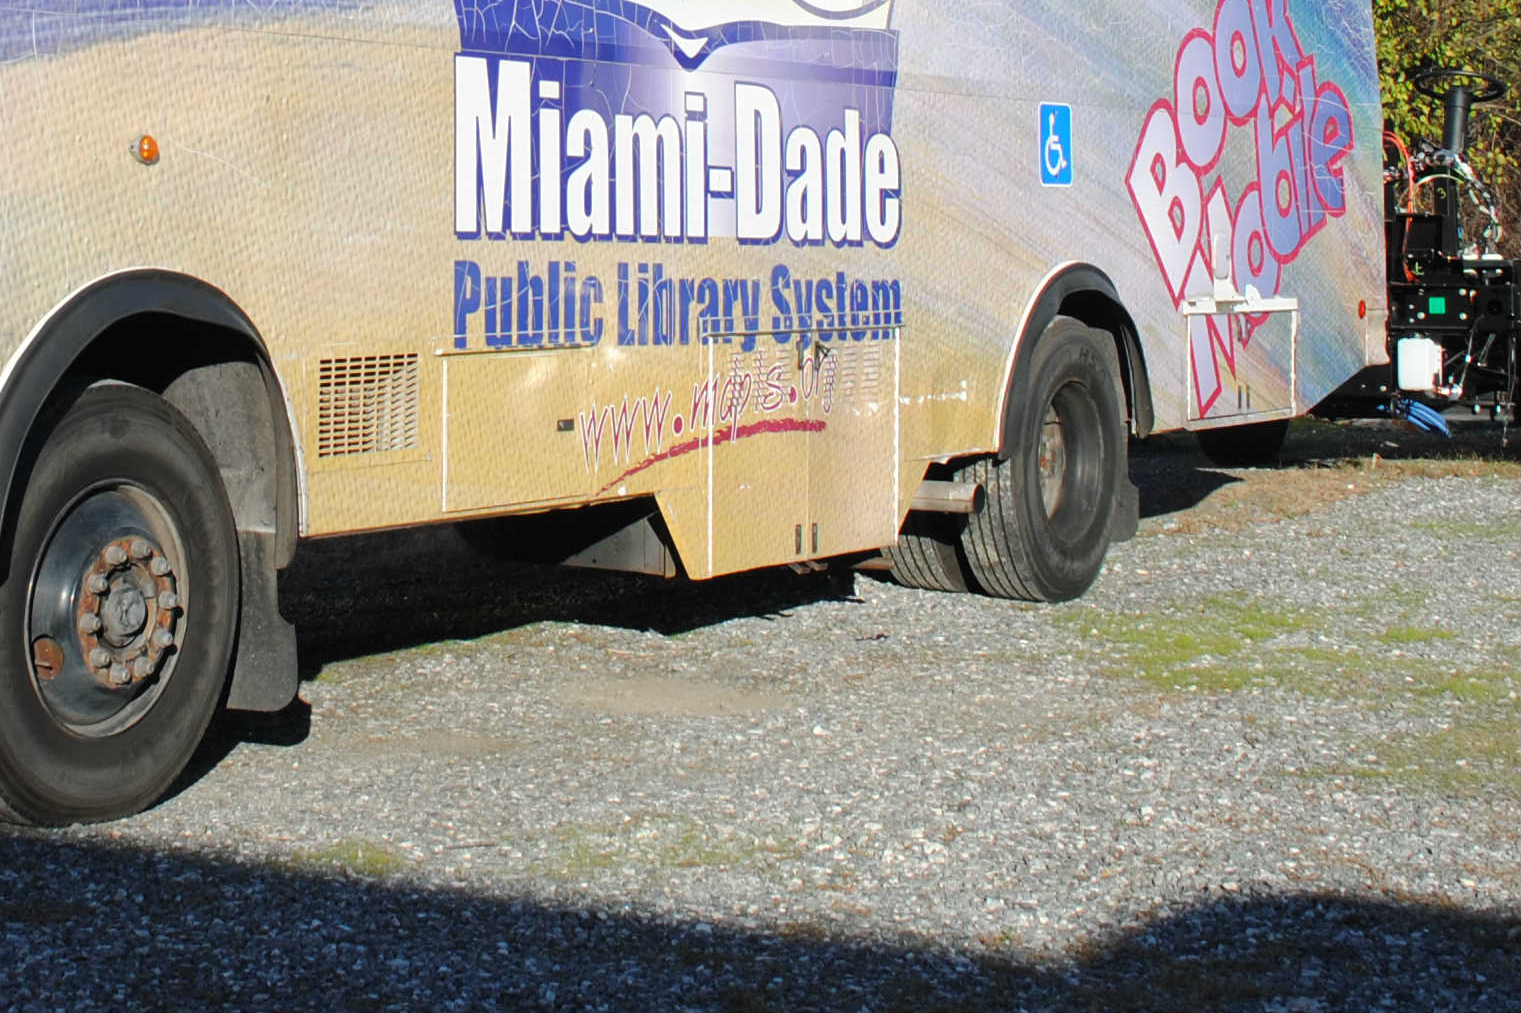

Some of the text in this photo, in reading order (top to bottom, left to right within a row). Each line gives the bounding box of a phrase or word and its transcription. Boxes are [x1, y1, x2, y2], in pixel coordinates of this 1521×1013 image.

[453, 52, 903, 249] Miami-Dade
[453, 259, 903, 352] Public Library System
